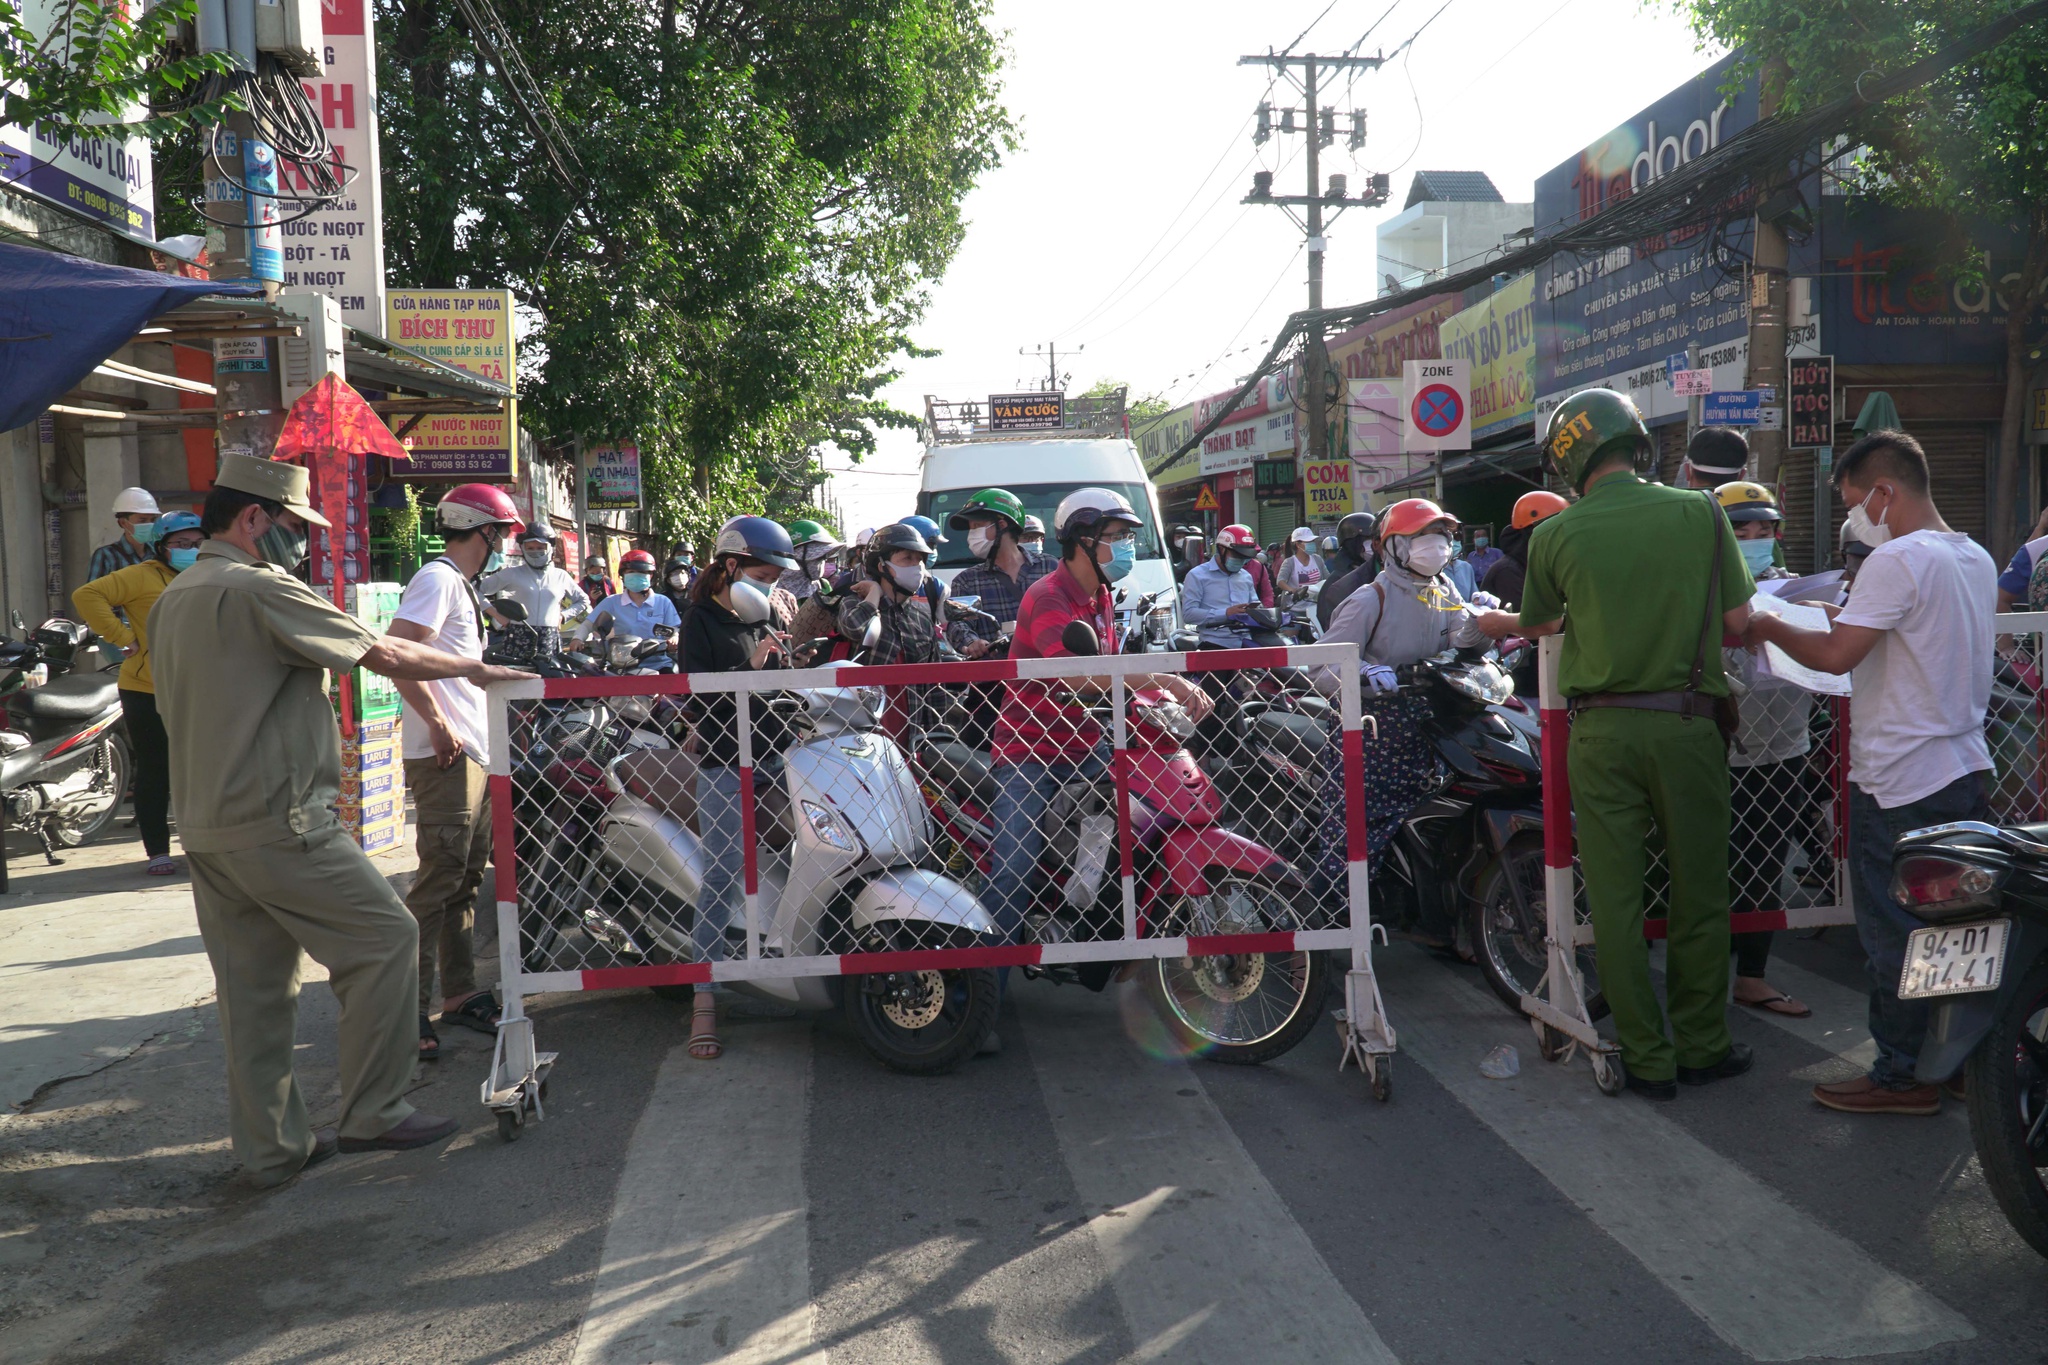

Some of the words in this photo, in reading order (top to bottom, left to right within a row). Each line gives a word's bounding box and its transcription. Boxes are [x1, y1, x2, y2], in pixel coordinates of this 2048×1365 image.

[107, 141, 142, 194] LOẠI
[84, 190, 107, 213] 0908
[127, 209, 143, 228] 362
[323, 222, 365, 239] NGỌT
[284, 243, 315, 264] BỘT
[330, 243, 351, 261] TÃ
[303, 271, 346, 289] NGỌT
[1576, 261, 1593, 287] TY
[341, 296, 365, 310] EM
[393, 295, 416, 310] CỬA
[420, 296, 450, 310] HÀNG
[453, 298, 475, 313] TẠP
[478, 296, 501, 310] HÓA
[1584, 291, 1618, 316] CHUYÊN
[1620, 280, 1638, 302] SẢN
[399, 313, 448, 339] BÍCH
[452, 318, 495, 339] THU
[1875, 317, 1890, 326] AN
[1479, 309, 1502, 366] BÒ
[429, 346, 452, 356] CUNG
[455, 343, 472, 356] CẤP
[1422, 366, 1453, 377] ZONE
[1792, 362, 1828, 386] HỚT
[1501, 366, 1527, 413] LỘC
[1718, 393, 1747, 403] ĐƯỜNG
[1793, 389, 1829, 412] TÓC
[995, 404, 1022, 417] VĂN
[1706, 406, 1727, 420] HUỲNH
[1729, 406, 1741, 420] VĂN
[398, 420, 419, 431] BA
[432, 417, 466, 431] NƯỚC
[470, 419, 503, 433] NGỌT
[1794, 417, 1828, 442] HẢI
[403, 435, 423, 447] GIA
[427, 436, 439, 448] VỊ
[443, 433, 468, 446] CÁC
[472, 435, 499, 448] LOẠI
[1235, 427, 1256, 450] ĐẠT
[1553, 411, 1593, 459] CSTT
[454, 452, 465, 460] ÍCH
[431, 461, 453, 469] 0908
[455, 461, 466, 469] 93
[468, 461, 479, 469] 53
[481, 461, 492, 469] 62
[607, 467, 637, 478] NHAU
[1306, 462, 1350, 485] CƠM
[1310, 486, 1348, 501] TRƯA
[588, 501, 601, 509] Vào
[1317, 503, 1341, 513] 23k
[364, 749, 390, 764] LARUE
[365, 775, 390, 791] LARUE
[365, 801, 390, 817] LARUE
[366, 827, 392, 845] LARUE
